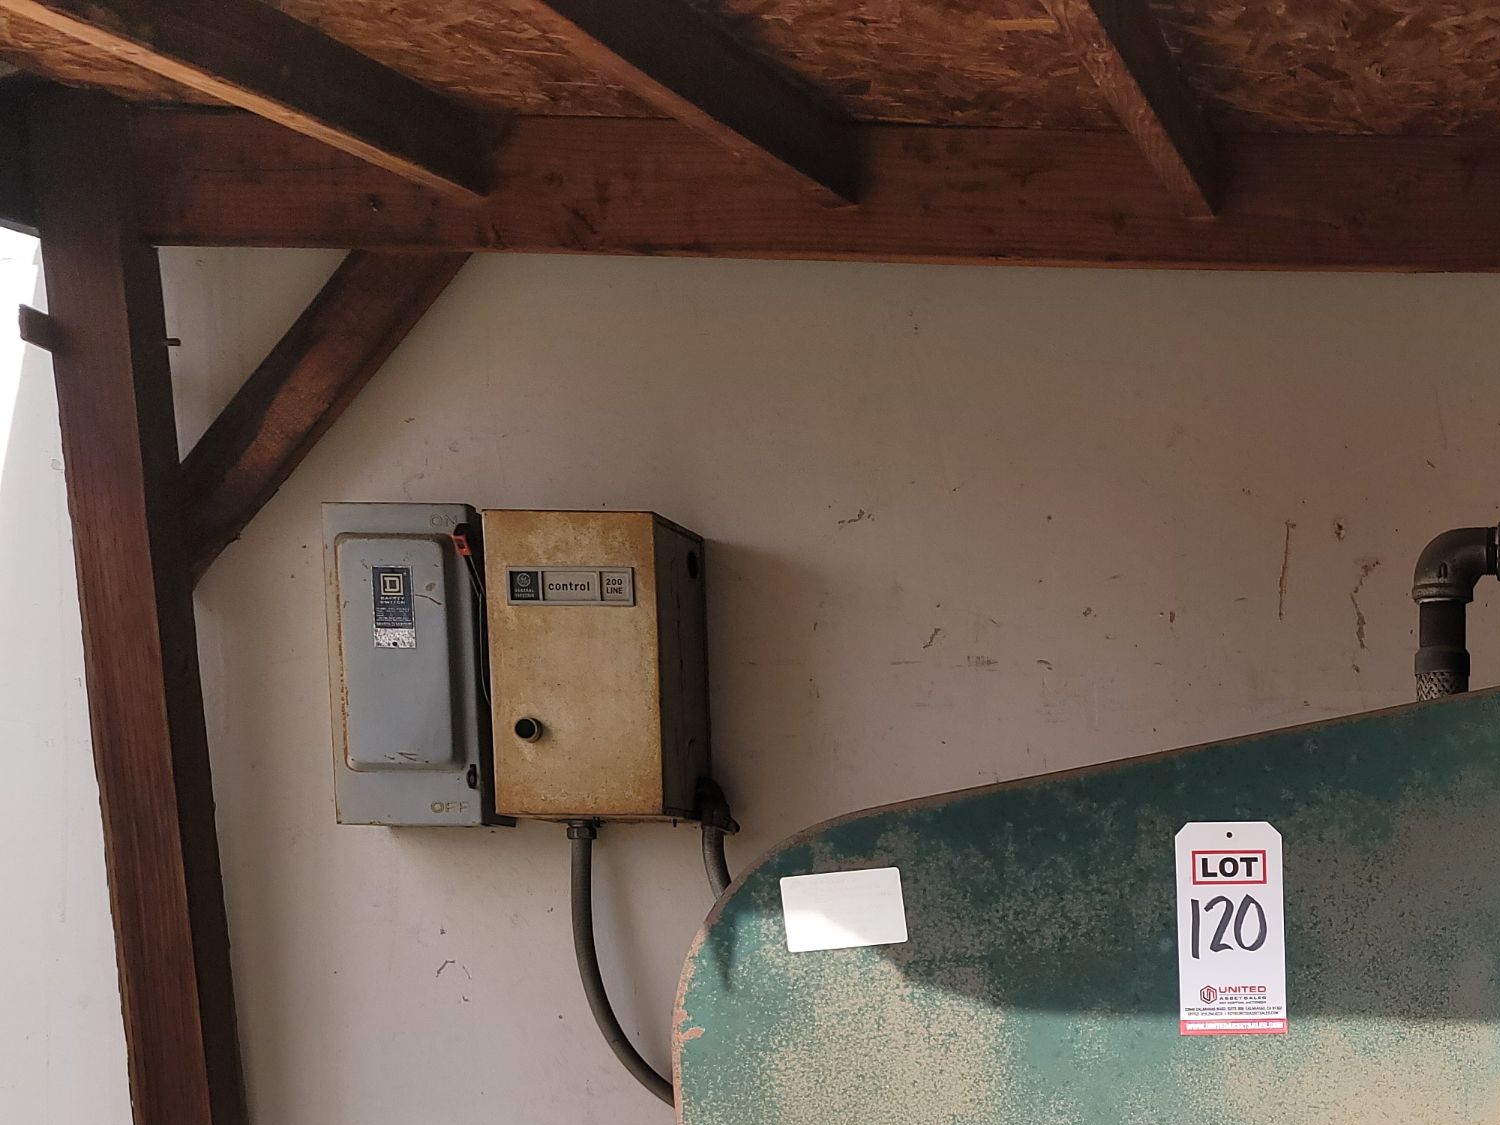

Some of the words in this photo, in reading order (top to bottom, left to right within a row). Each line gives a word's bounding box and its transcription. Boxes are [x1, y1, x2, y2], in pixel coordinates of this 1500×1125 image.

[548, 581, 590, 591] control
[606, 578, 623, 586] 200
[606, 587, 623, 595] LINE
[431, 801, 469, 813] OFF
[1201, 857, 1258, 878] LOT
[1190, 893, 1267, 960] 120
[1218, 985, 1267, 994] UNITED
